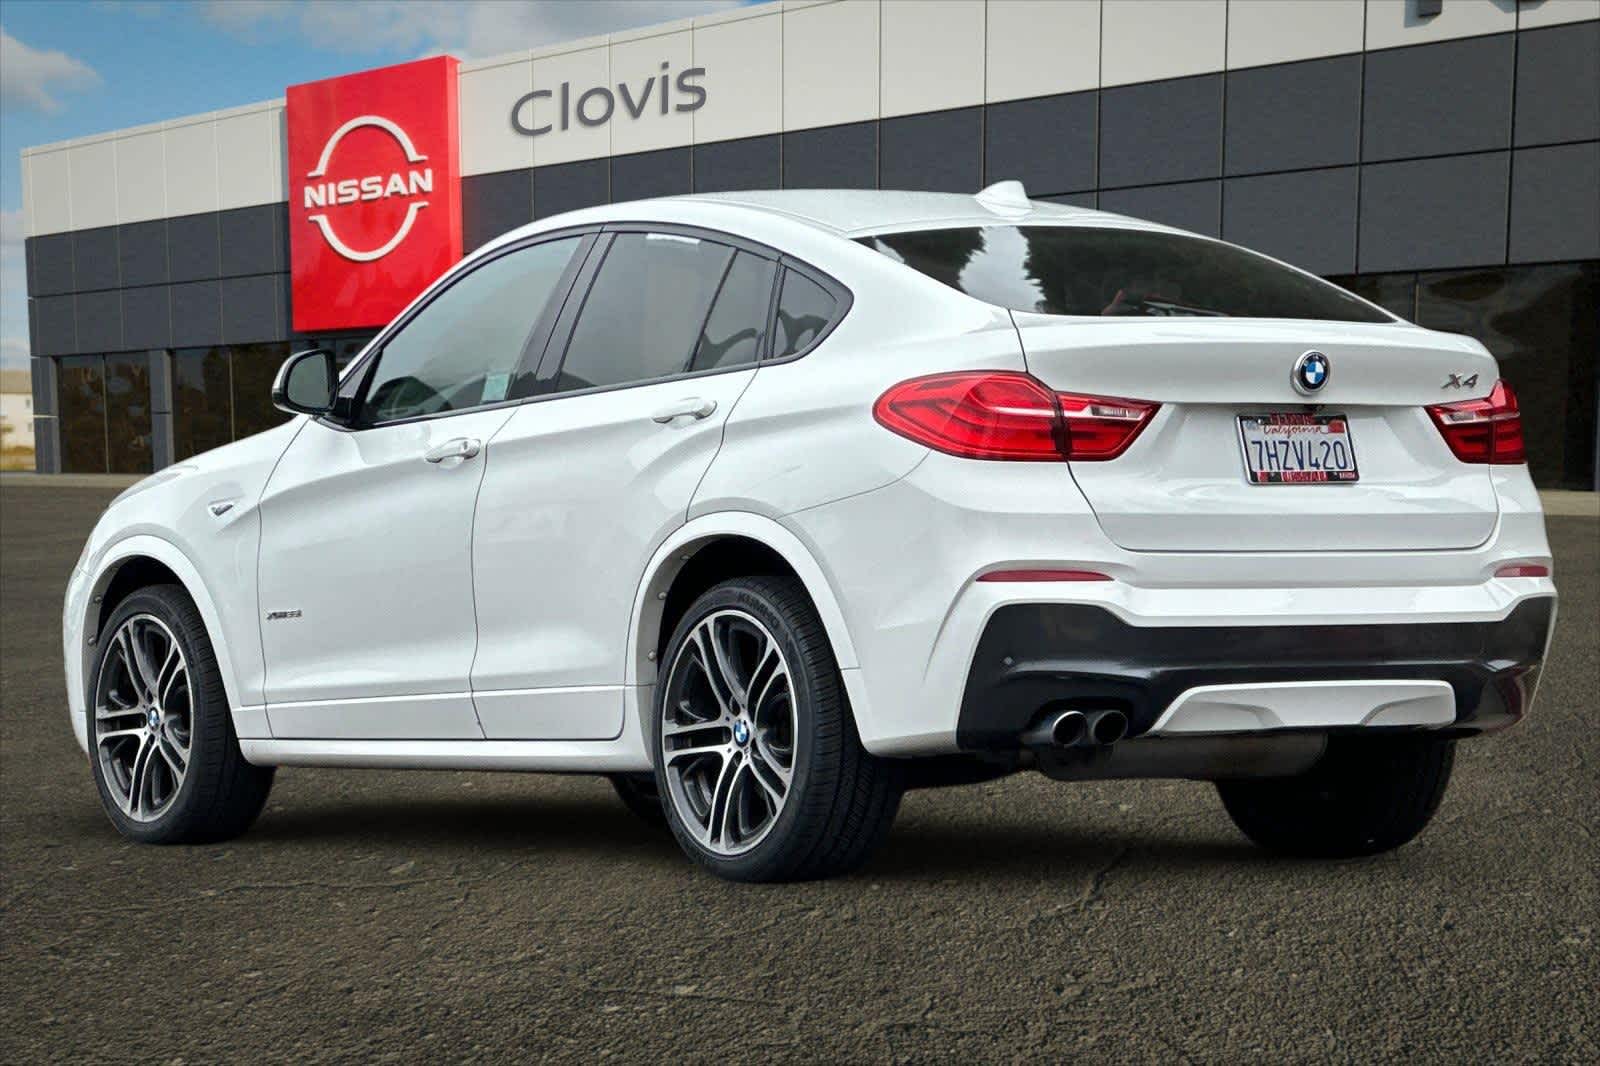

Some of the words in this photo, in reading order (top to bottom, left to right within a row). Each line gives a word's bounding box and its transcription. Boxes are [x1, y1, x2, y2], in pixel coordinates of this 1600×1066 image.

[511, 61, 706, 136] Clovis
[303, 168, 433, 209] NISSAN
[1441, 373, 1479, 389] X4
[1251, 440, 1347, 471] 7HZV420
